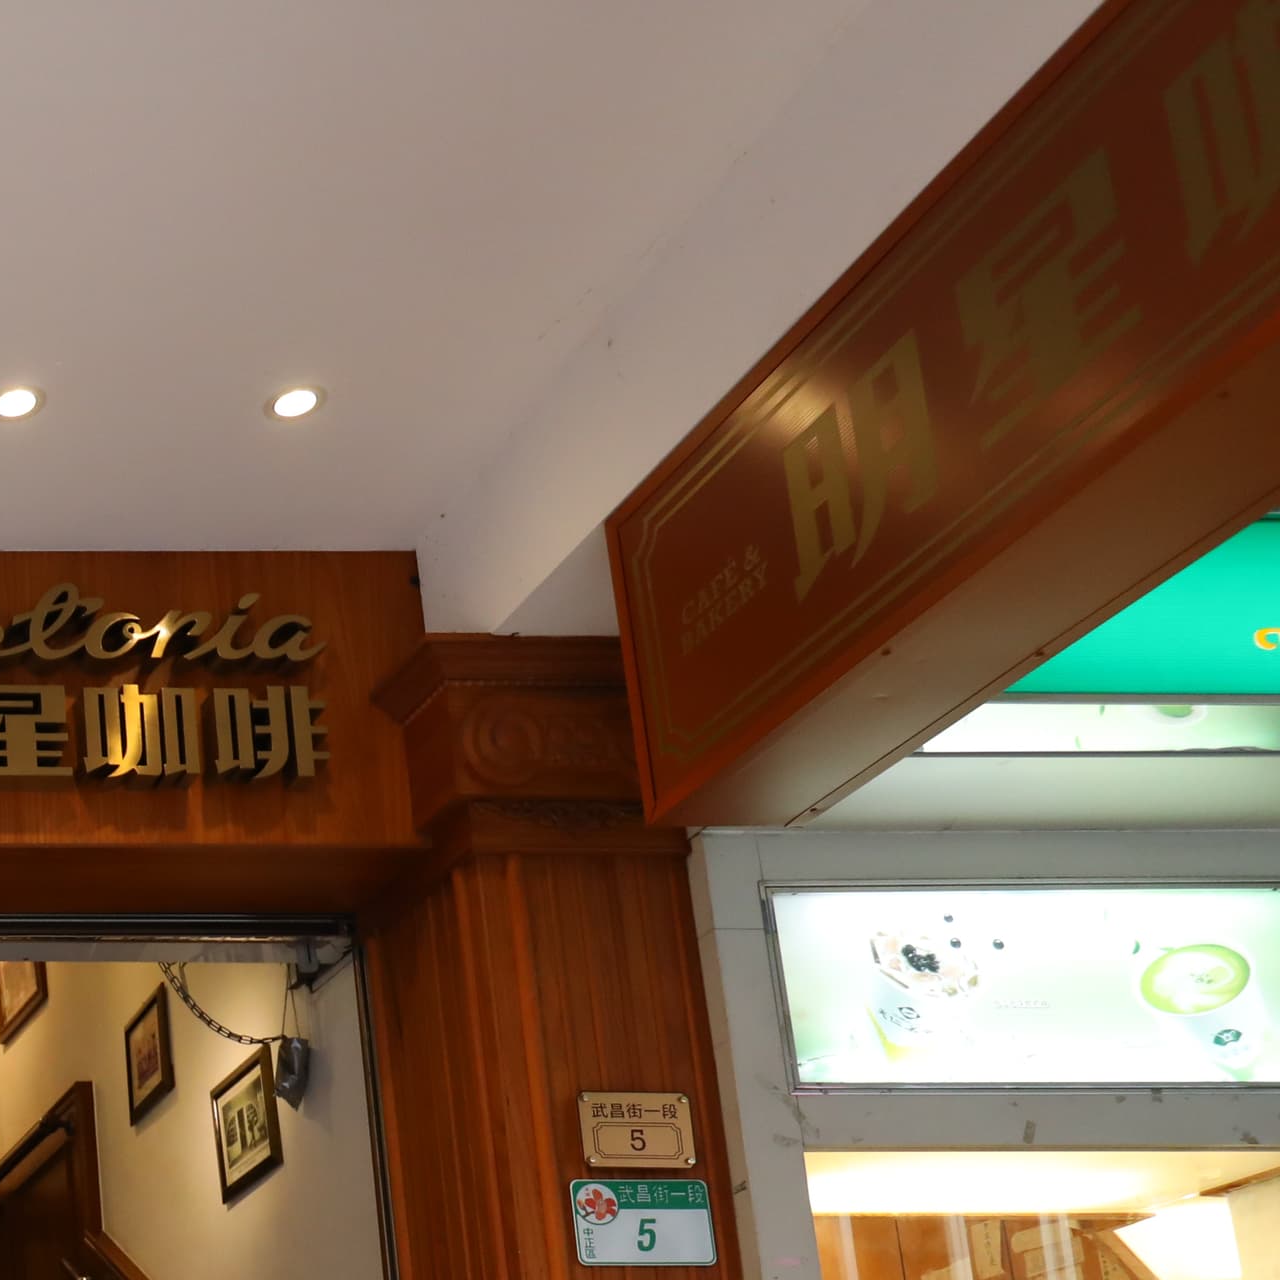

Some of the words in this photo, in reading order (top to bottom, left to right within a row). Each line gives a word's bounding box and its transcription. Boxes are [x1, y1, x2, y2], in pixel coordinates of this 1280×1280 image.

[680, 560, 769, 656] BAKERY
[591, 1103, 679, 1119] 武昌街一段
[630, 1129, 647, 1151] 5
[618, 1184, 705, 1204] 武昌街一段
[637, 1218, 657, 1252] 5
